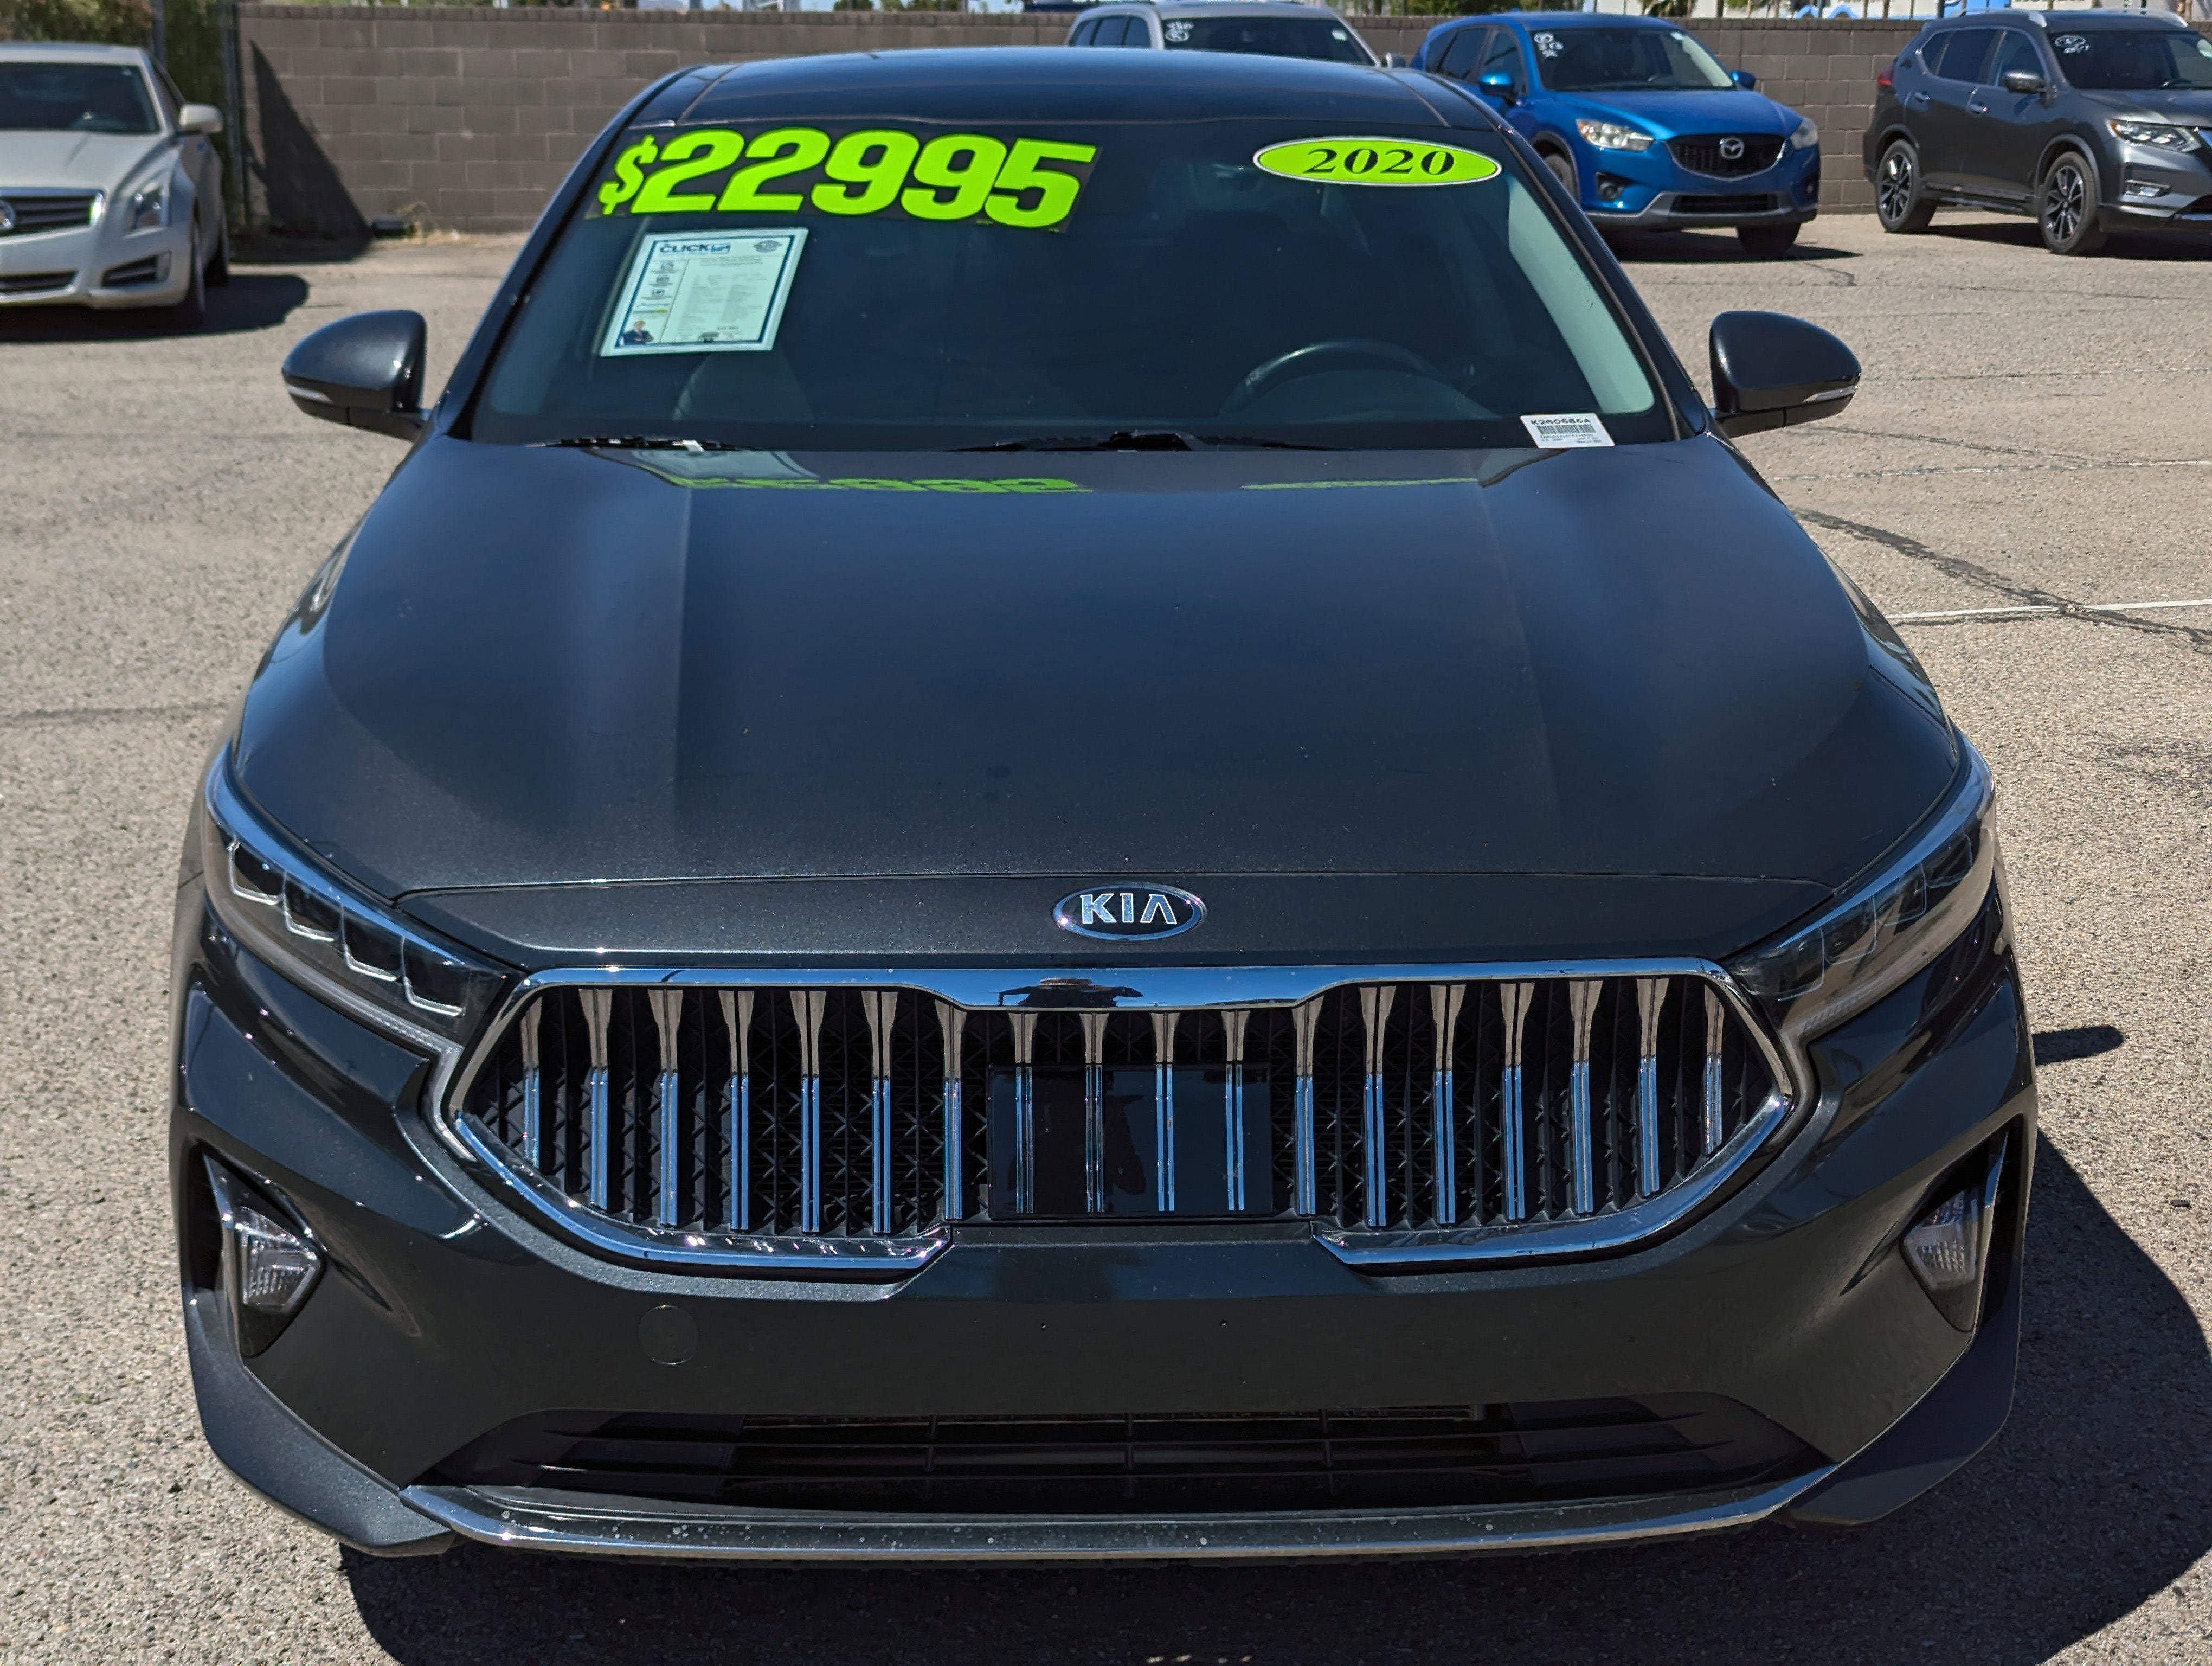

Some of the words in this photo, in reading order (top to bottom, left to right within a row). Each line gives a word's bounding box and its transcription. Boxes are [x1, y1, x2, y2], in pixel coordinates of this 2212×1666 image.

[1303, 148, 1454, 176] 2020
[599, 128, 1096, 227] $22995
[660, 244, 709, 253] CLICK
[1080, 893, 1177, 925] KIA
